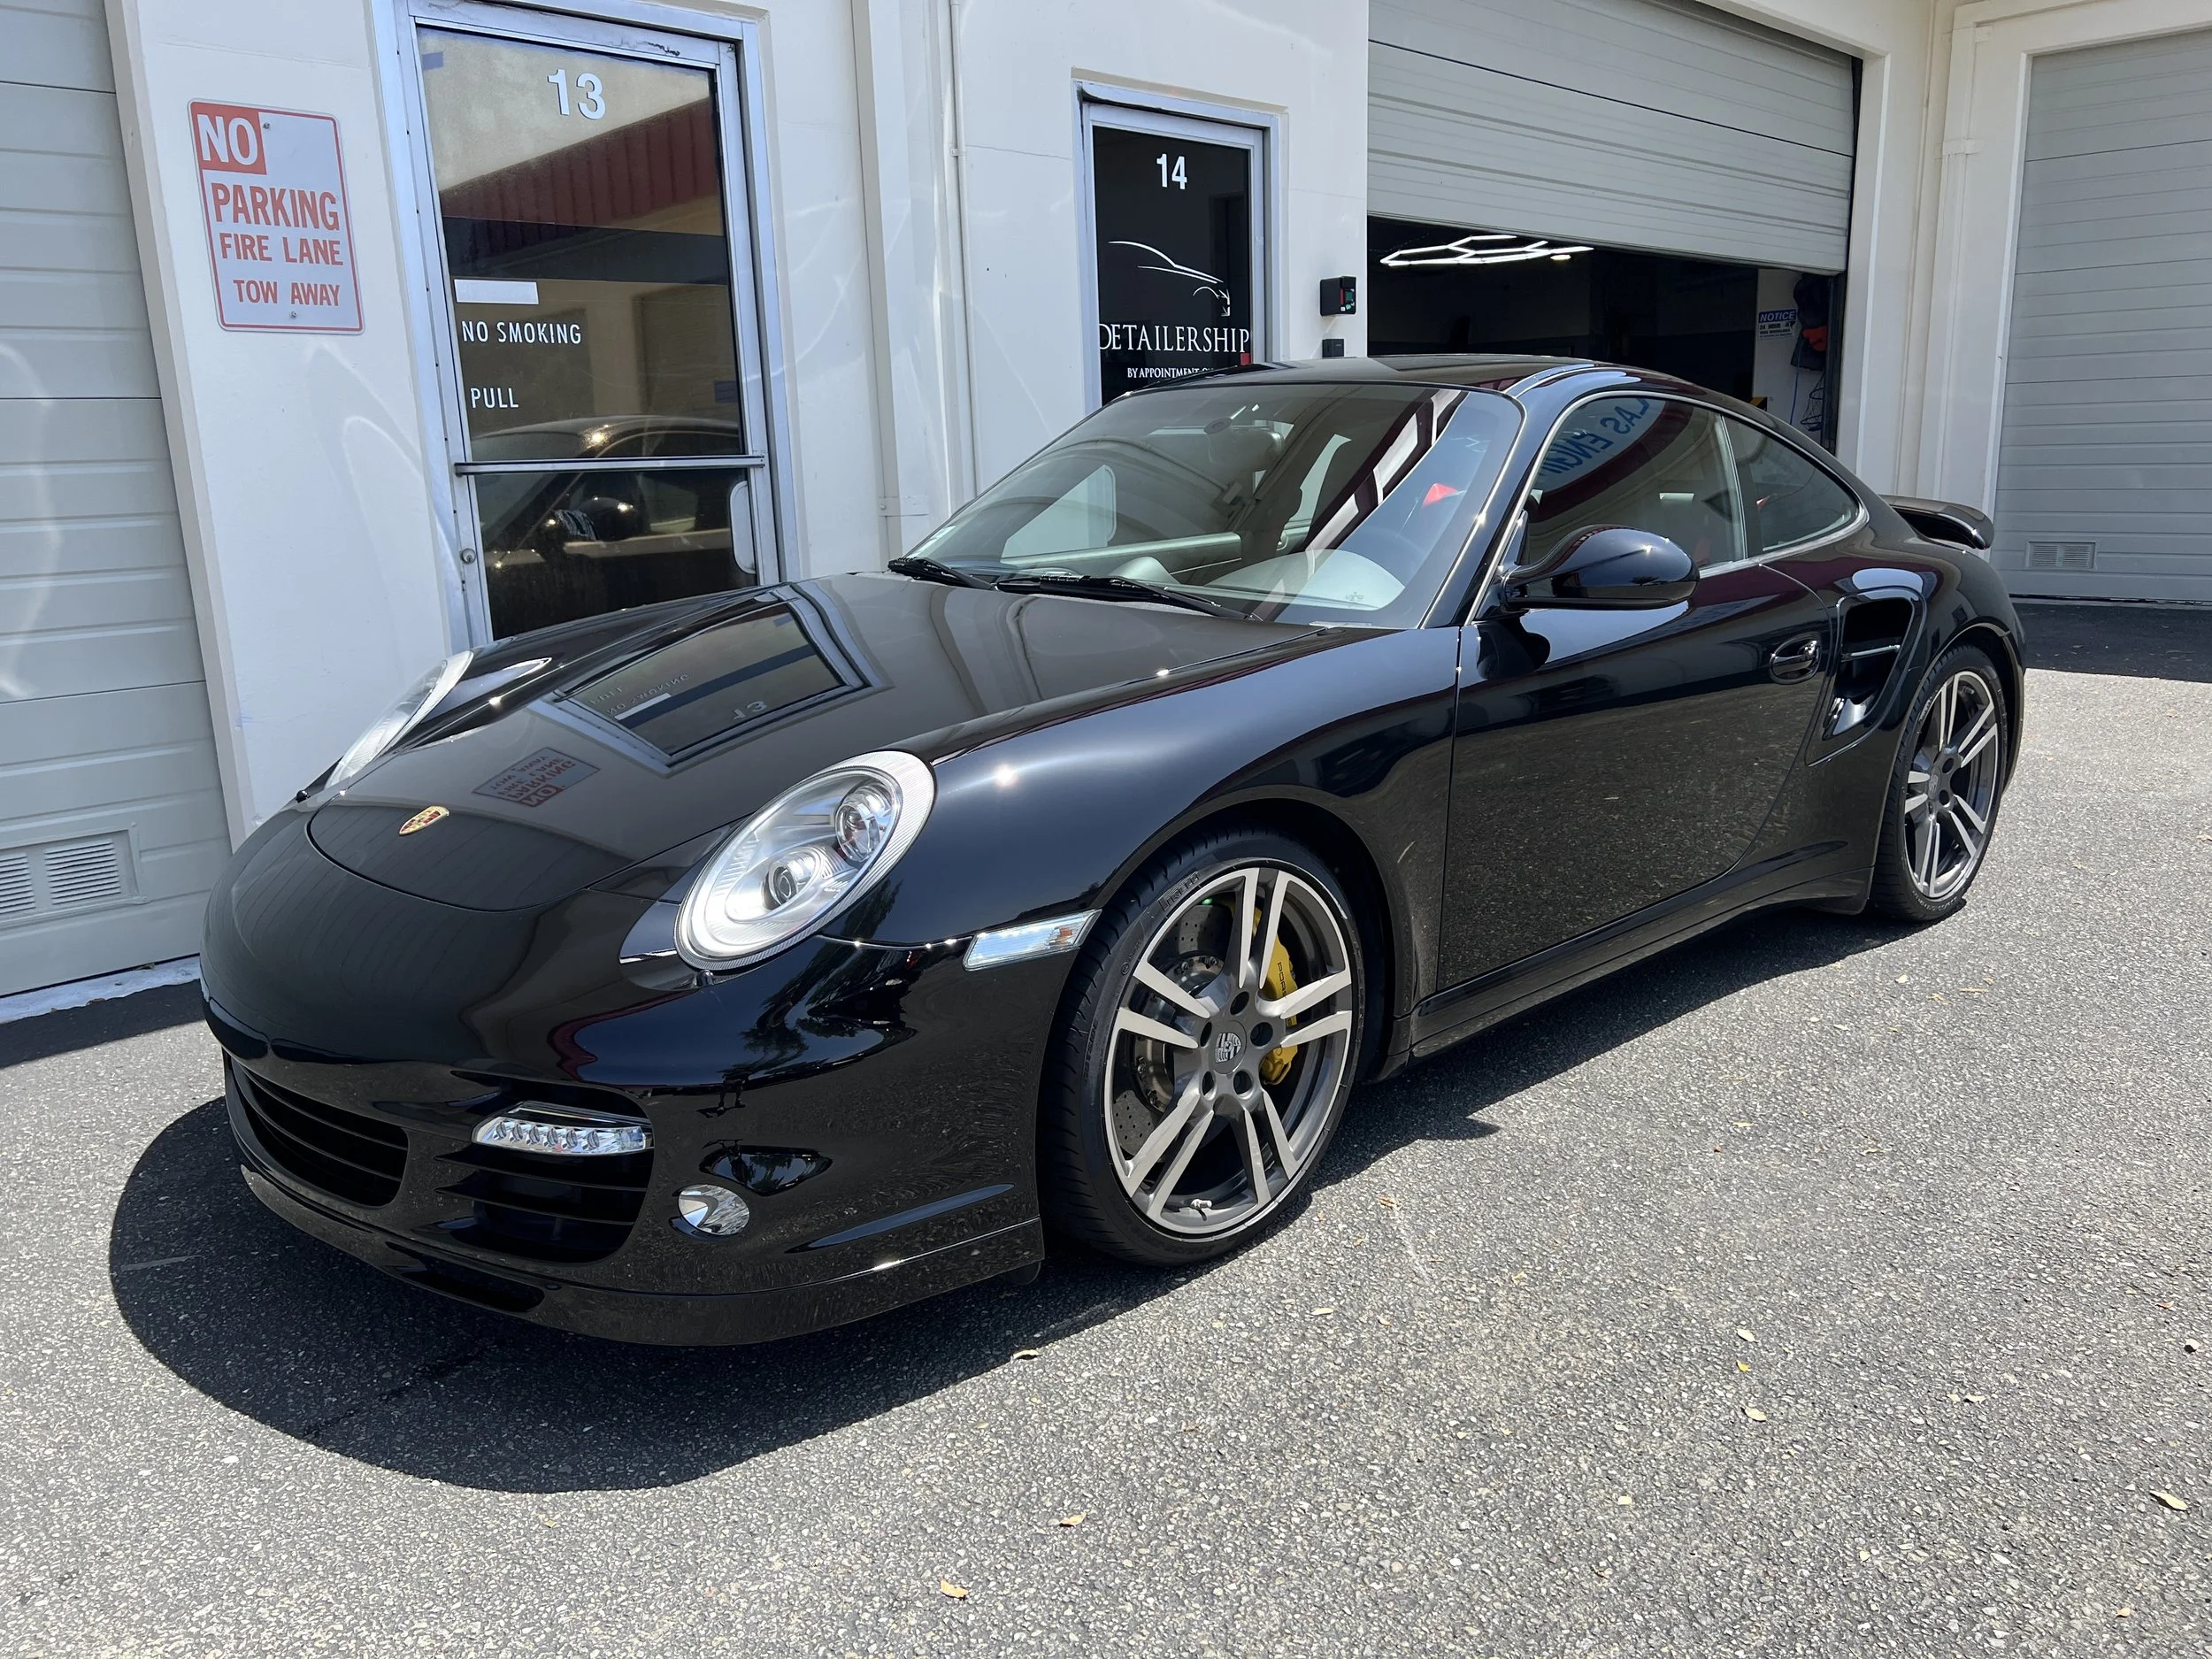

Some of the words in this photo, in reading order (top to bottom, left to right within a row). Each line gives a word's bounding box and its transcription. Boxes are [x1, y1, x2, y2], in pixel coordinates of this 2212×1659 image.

[547, 68, 606, 120] 13
[196, 113, 258, 165] NO
[1156, 153, 1187, 190] 14
[211, 181, 340, 231] PARKING
[219, 232, 273, 262] FIRE
[282, 236, 343, 266] LANE
[233, 279, 278, 304] TOW
[290, 282, 341, 307] AWAY
[1760, 311, 1794, 322] NOTICE
[461, 320, 488, 342] NO
[496, 321, 581, 344] SMOKING
[1099, 323, 1249, 353] DETAILERSHIP
[1127, 367, 1139, 379] BY
[470, 387, 519, 409] PULL
